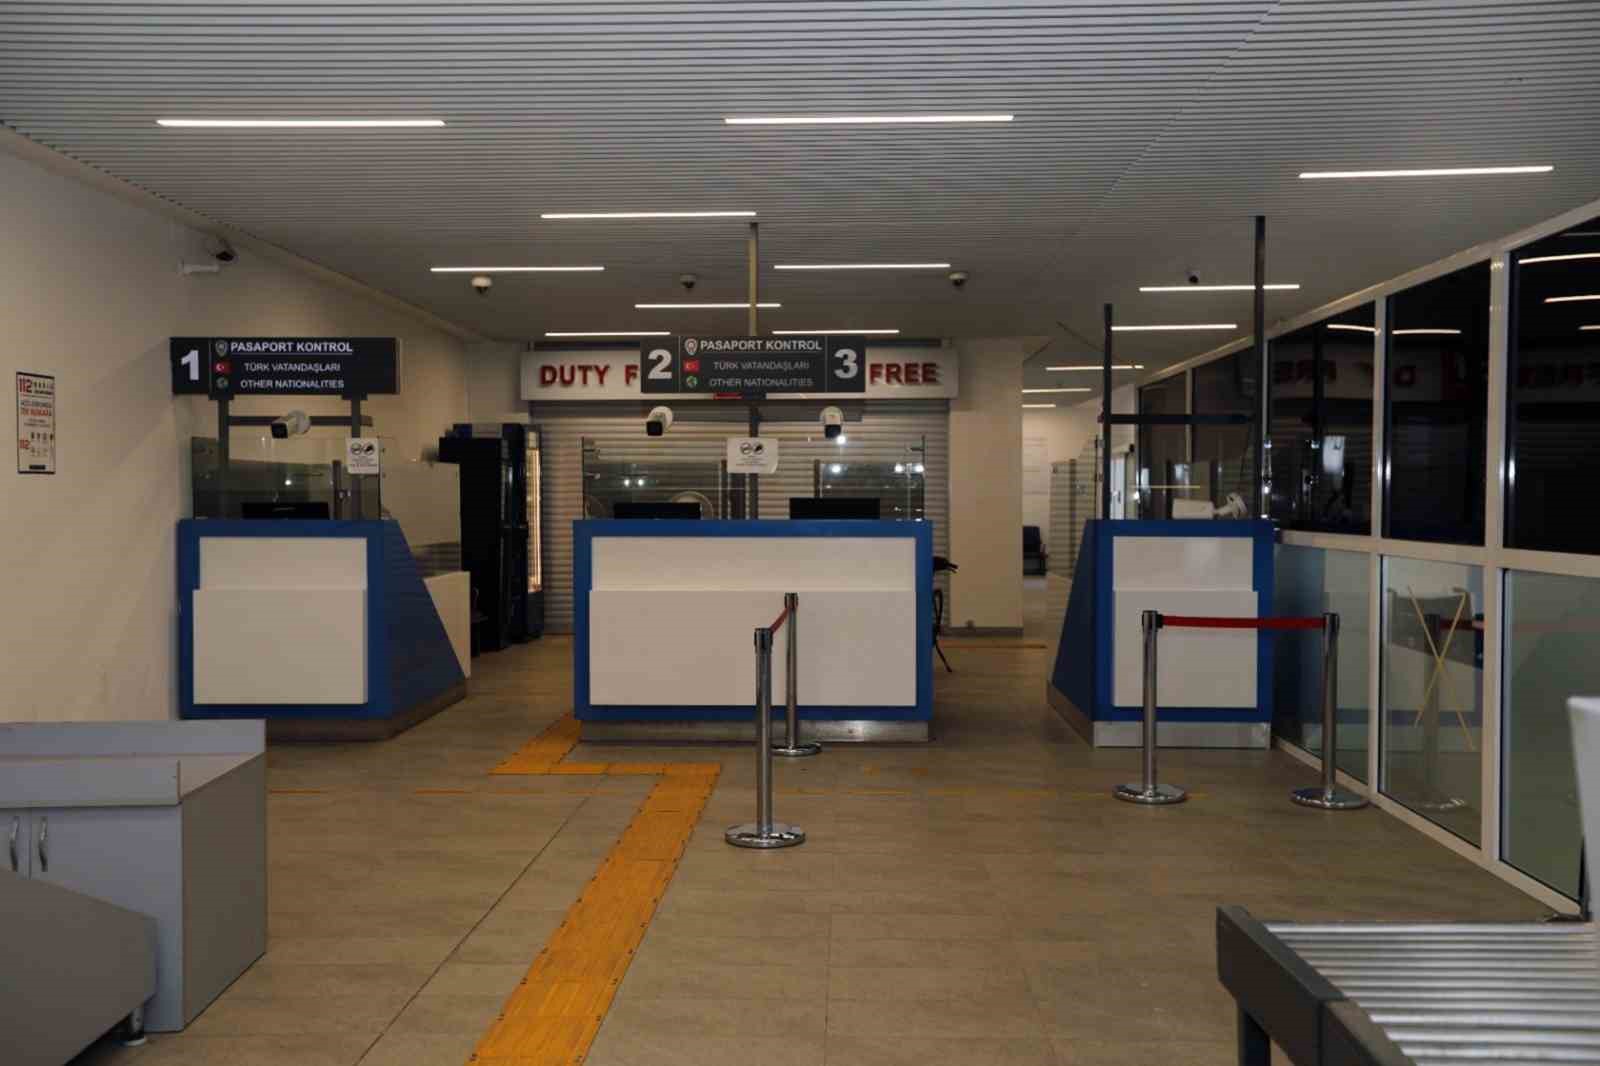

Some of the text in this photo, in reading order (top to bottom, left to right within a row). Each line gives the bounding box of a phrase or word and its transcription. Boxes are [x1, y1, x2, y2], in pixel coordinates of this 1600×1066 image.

[231, 342, 353, 352] PASAPORT KONTROL
[700, 340, 823, 350] PASAPORT KONTROL
[180, 349, 200, 381] 1
[244, 361, 341, 373] TÜRK VATANDAŞLARI
[647, 348, 673, 380] 2
[713, 360, 810, 372] TÜRK VATANDAŞLARI
[833, 348, 859, 379] 3
[540, 362, 938, 386] DUTY F FREE
[240, 378, 344, 389] OTHER NATIONALITIES
[709, 377, 813, 387] OTHER NATIONALITIES
